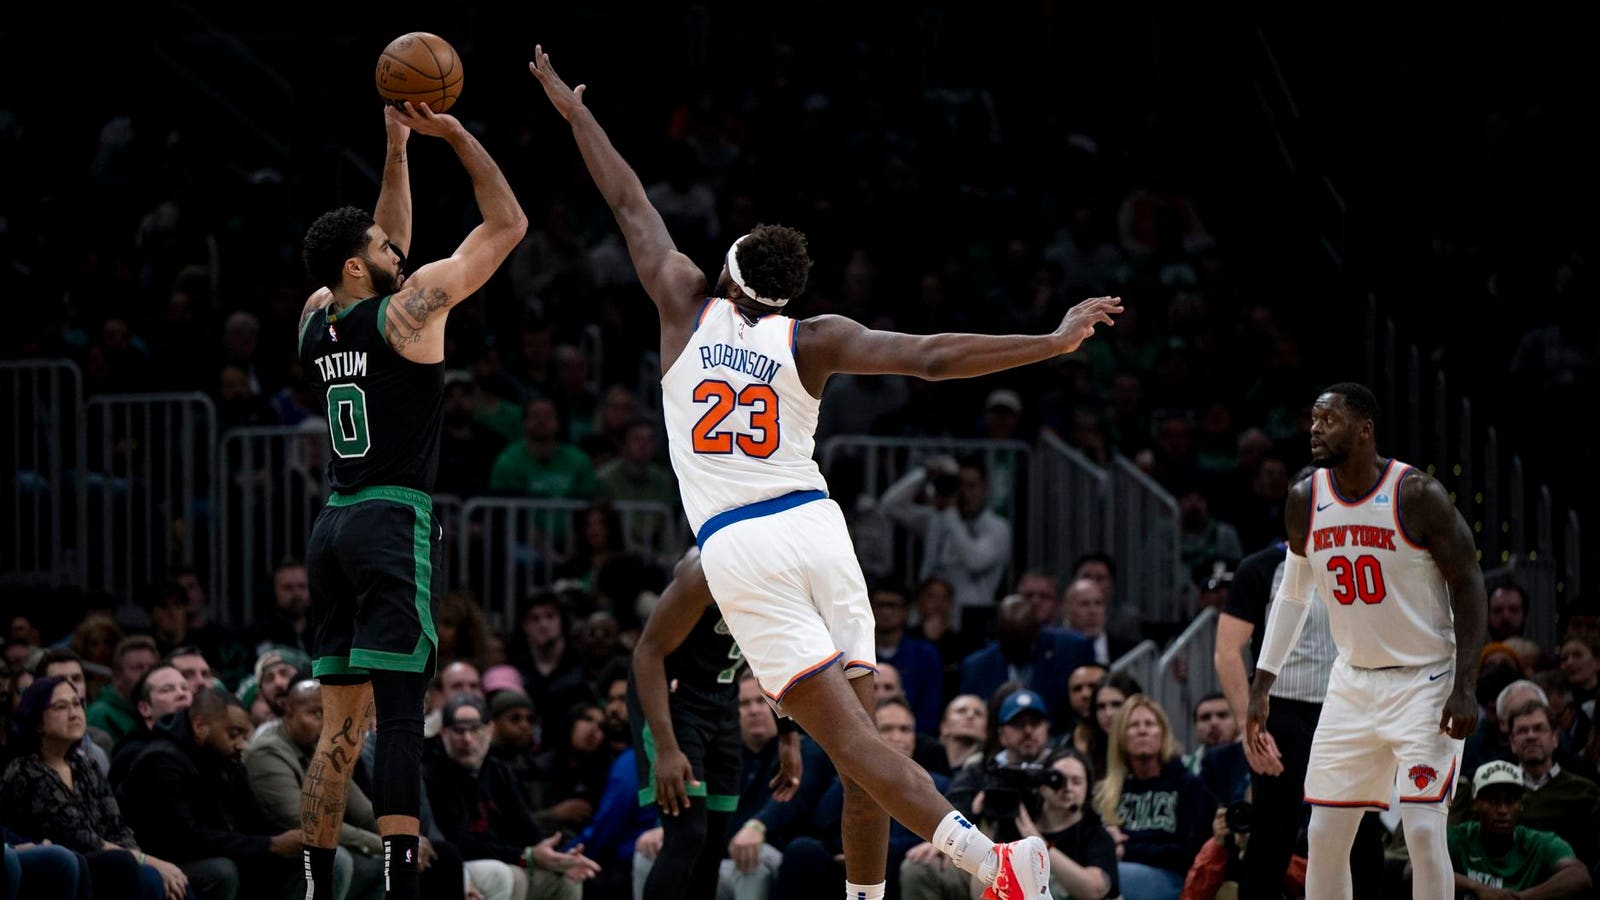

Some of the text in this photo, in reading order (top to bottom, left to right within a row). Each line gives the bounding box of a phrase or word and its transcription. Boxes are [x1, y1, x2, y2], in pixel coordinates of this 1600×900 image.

[314, 351, 367, 382] TATUM
[699, 343, 781, 384] ROBINSON
[326, 382, 371, 458] 0
[692, 379, 780, 459] 23
[1313, 525, 1396, 552] NEW YORK
[1327, 555, 1386, 605] 30
